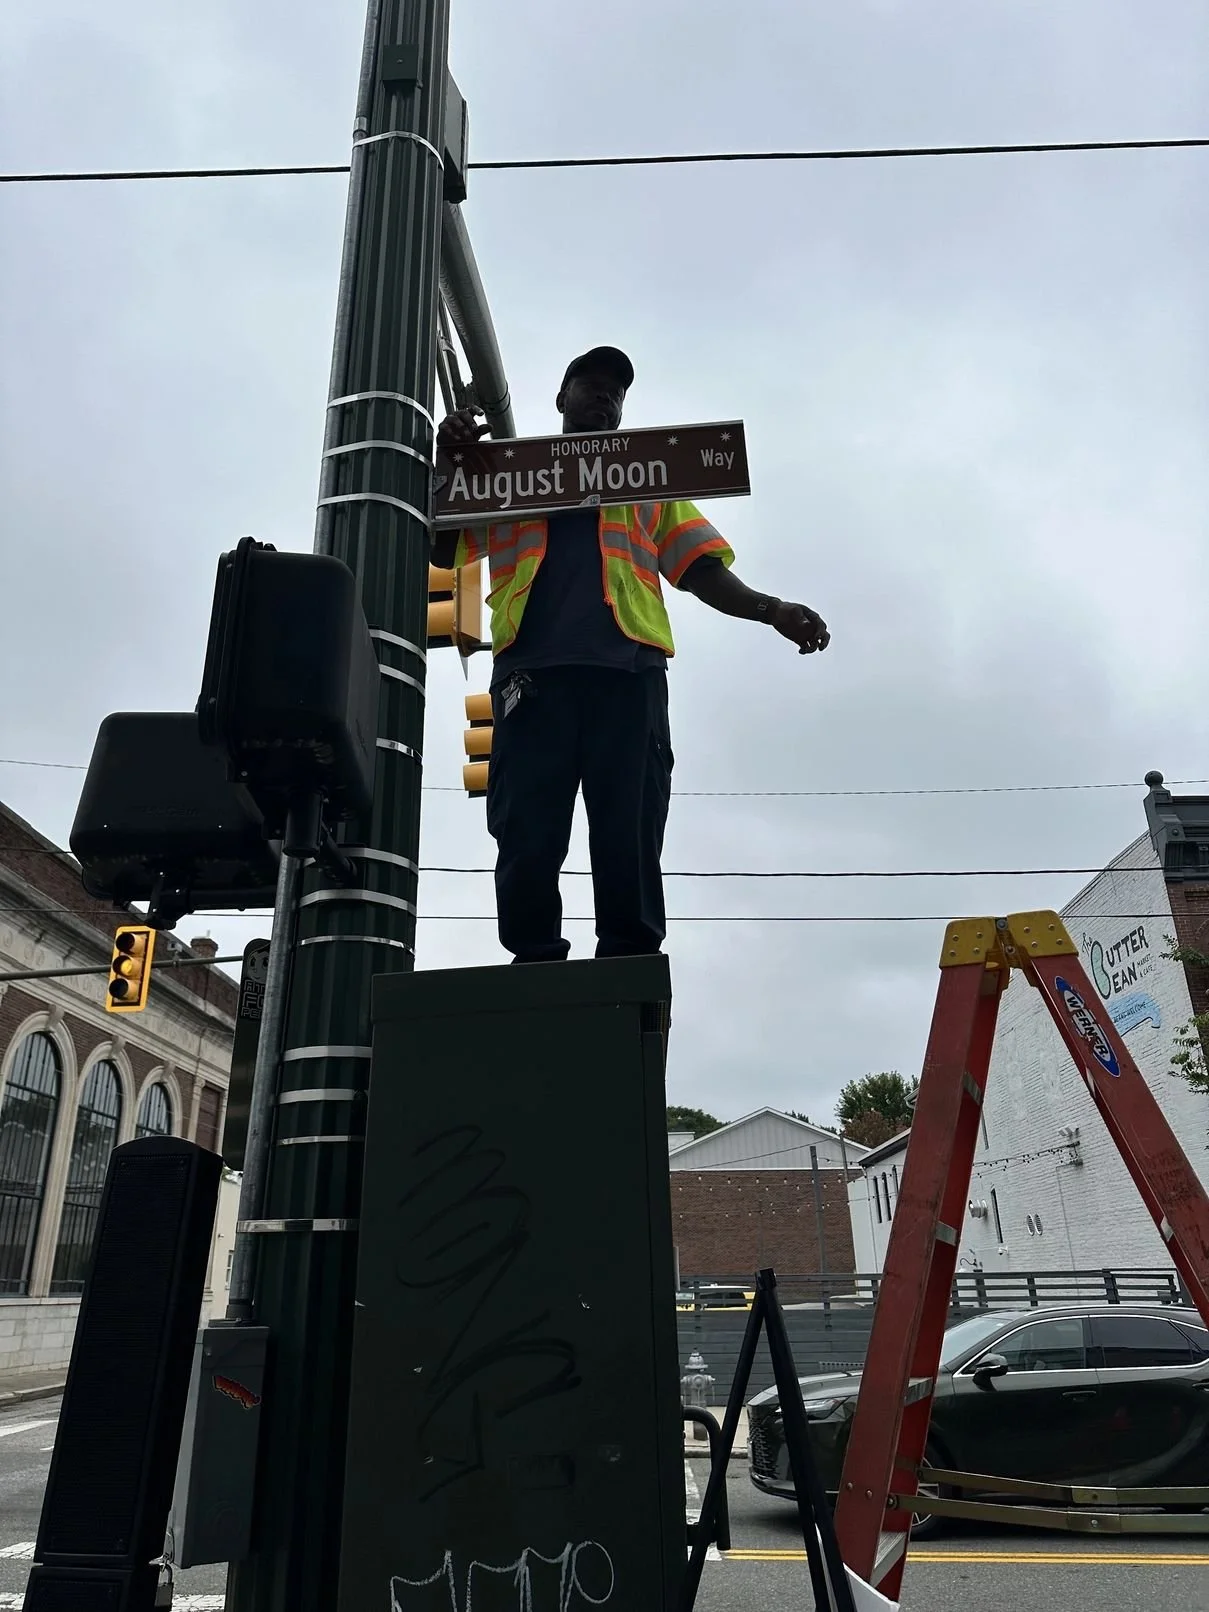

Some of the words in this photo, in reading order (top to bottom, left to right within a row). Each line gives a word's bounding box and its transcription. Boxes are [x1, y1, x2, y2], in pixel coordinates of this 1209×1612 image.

[551, 437, 630, 457] HONORARY
[448, 460, 564, 509] August
[579, 456, 668, 492] Moon
[700, 449, 735, 470] Way
[1066, 996, 1109, 1057] WERNER
